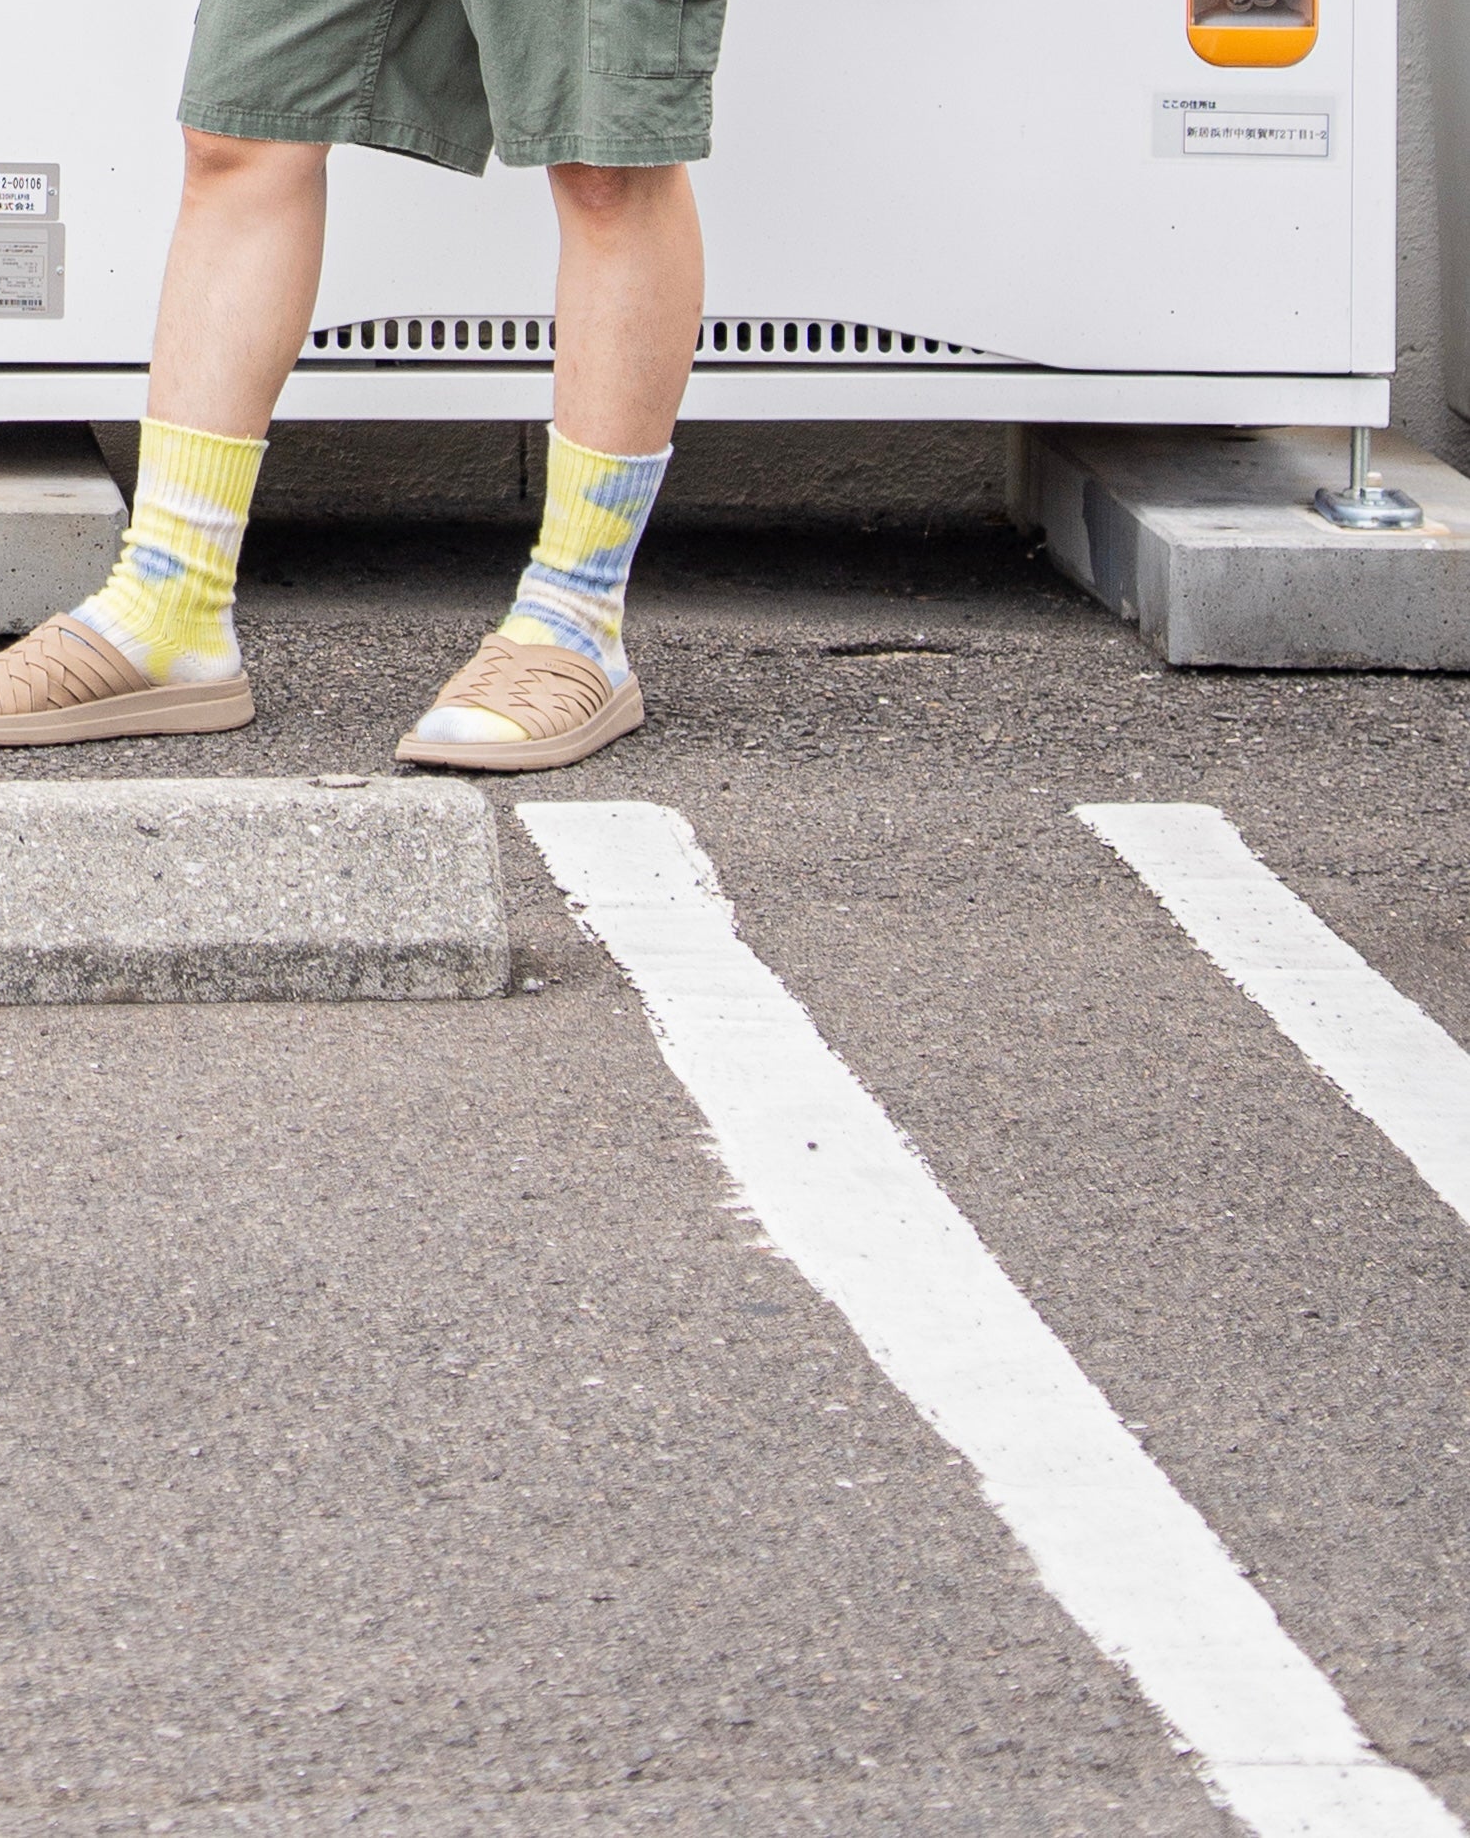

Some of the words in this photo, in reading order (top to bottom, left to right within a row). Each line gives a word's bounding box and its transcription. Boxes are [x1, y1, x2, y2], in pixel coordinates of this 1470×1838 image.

[1162, 99, 1217, 110] ここの住所は
